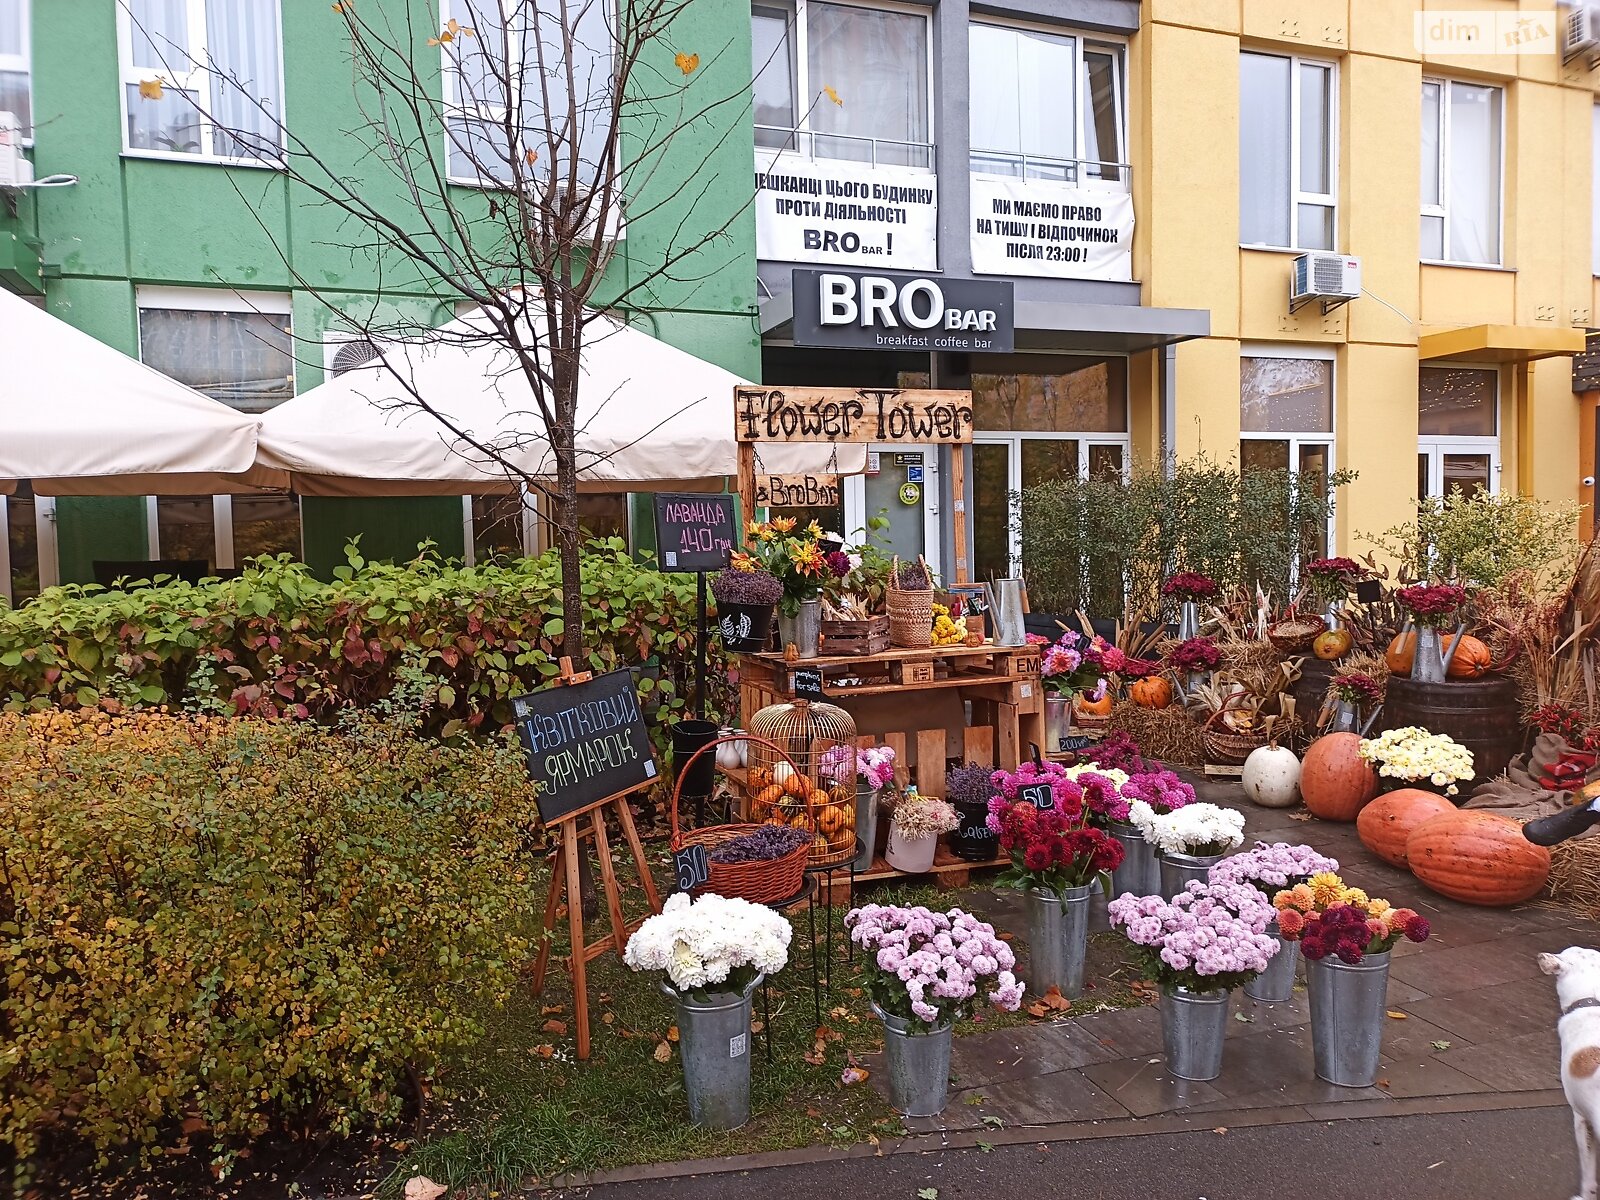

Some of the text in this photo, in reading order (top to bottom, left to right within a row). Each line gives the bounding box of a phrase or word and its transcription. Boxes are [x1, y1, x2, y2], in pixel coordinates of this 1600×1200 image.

[825, 179, 869, 199] ЦЬОГО
[872, 183, 933, 205] БУДИНКУ
[775, 198, 907, 224] ПРОТИ ДІЯЛЬНОСТІ
[992, 198, 1102, 222] МИ МАЄМО ПРАВО
[803, 229, 861, 253] BRO
[861, 246, 883, 255] BAR
[976, 218, 1118, 243] НА ТИШУ І ВІДПОЧИНОК
[1006, 243, 1044, 260] ПІСЛЯ
[1046, 246, 1081, 262] 23:00
[820, 273, 997, 331] BRO BAR
[876, 333, 992, 348] breakfast coffee bar
[737, 389, 973, 439] Flower Tower
[666, 502, 726, 526] ЛАВАНДА
[527, 685, 639, 753] КВІТКОВИЙ
[544, 728, 638, 795] ЯРМАРОК
[1023, 784, 1054, 808] 50
[676, 844, 708, 890] 50
